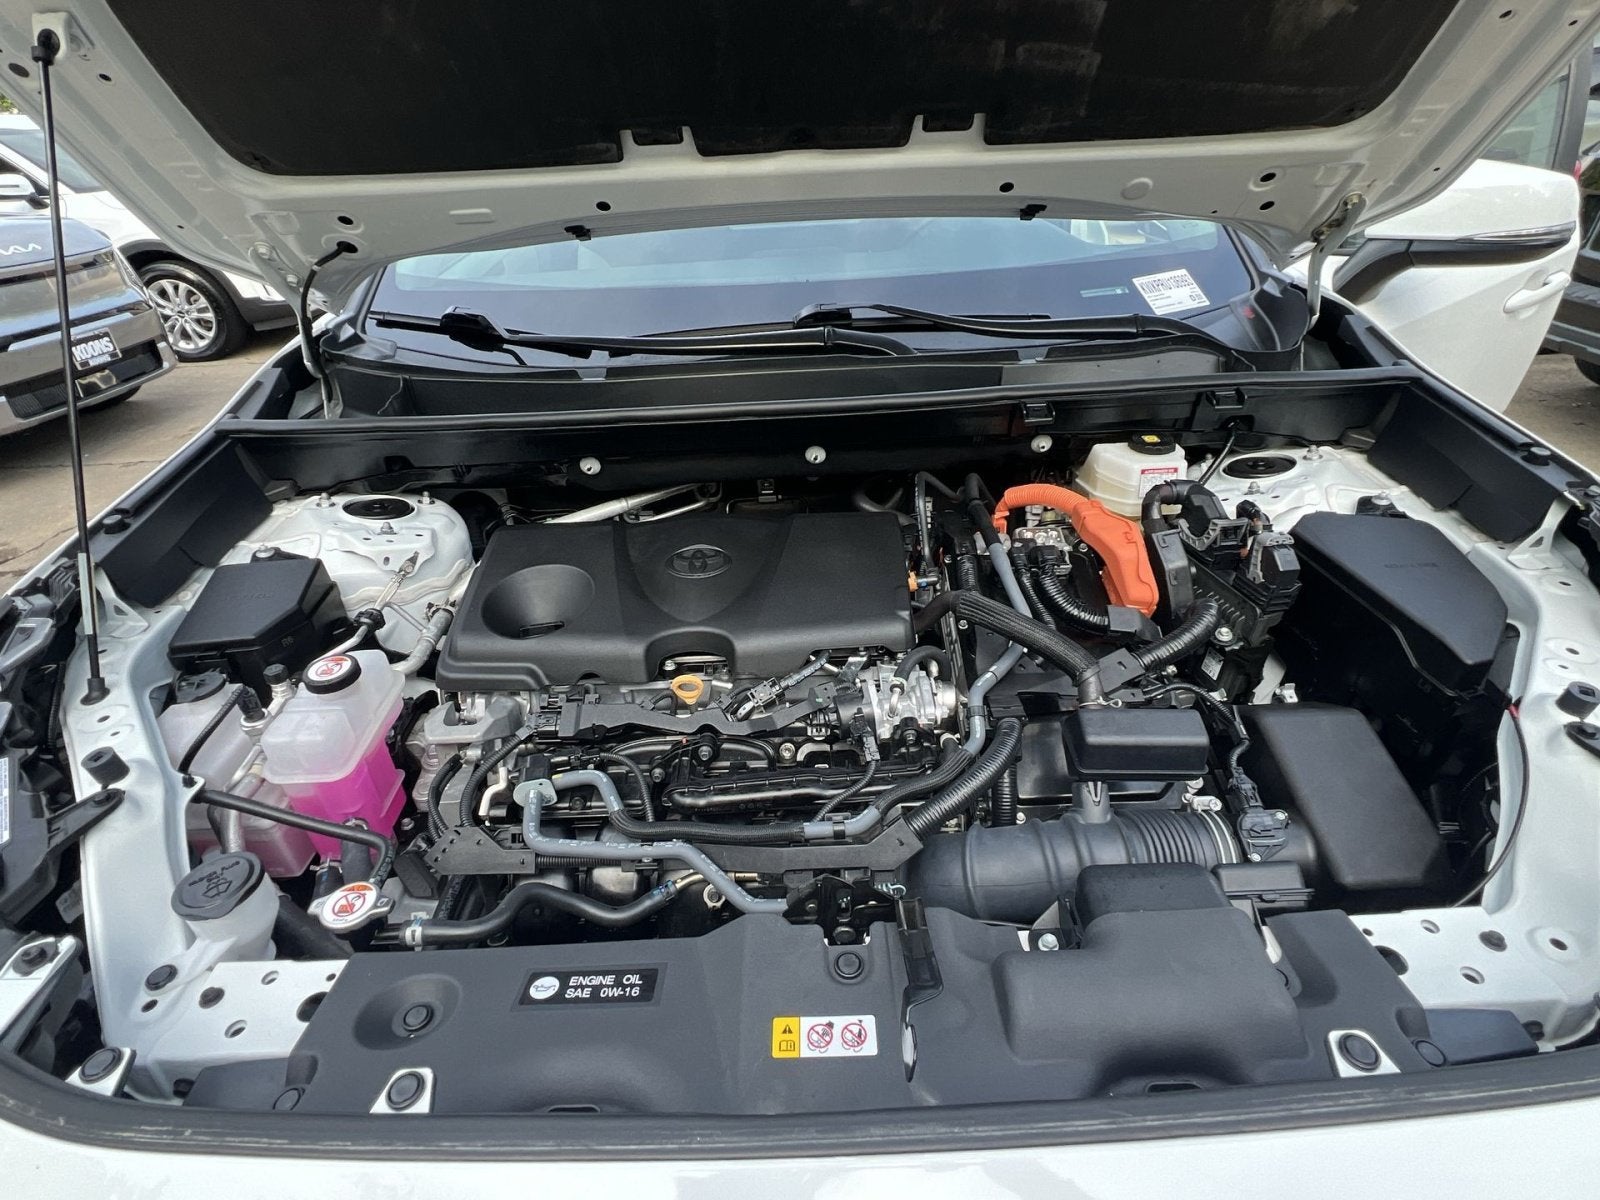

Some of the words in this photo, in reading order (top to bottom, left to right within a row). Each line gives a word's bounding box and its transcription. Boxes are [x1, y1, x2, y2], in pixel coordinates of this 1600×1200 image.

[71, 336, 115, 361] KOONS
[568, 974, 616, 987] ENGINE
[622, 973, 643, 985] OIL
[564, 987, 593, 999] SAE
[599, 986, 640, 998] 0W-16
